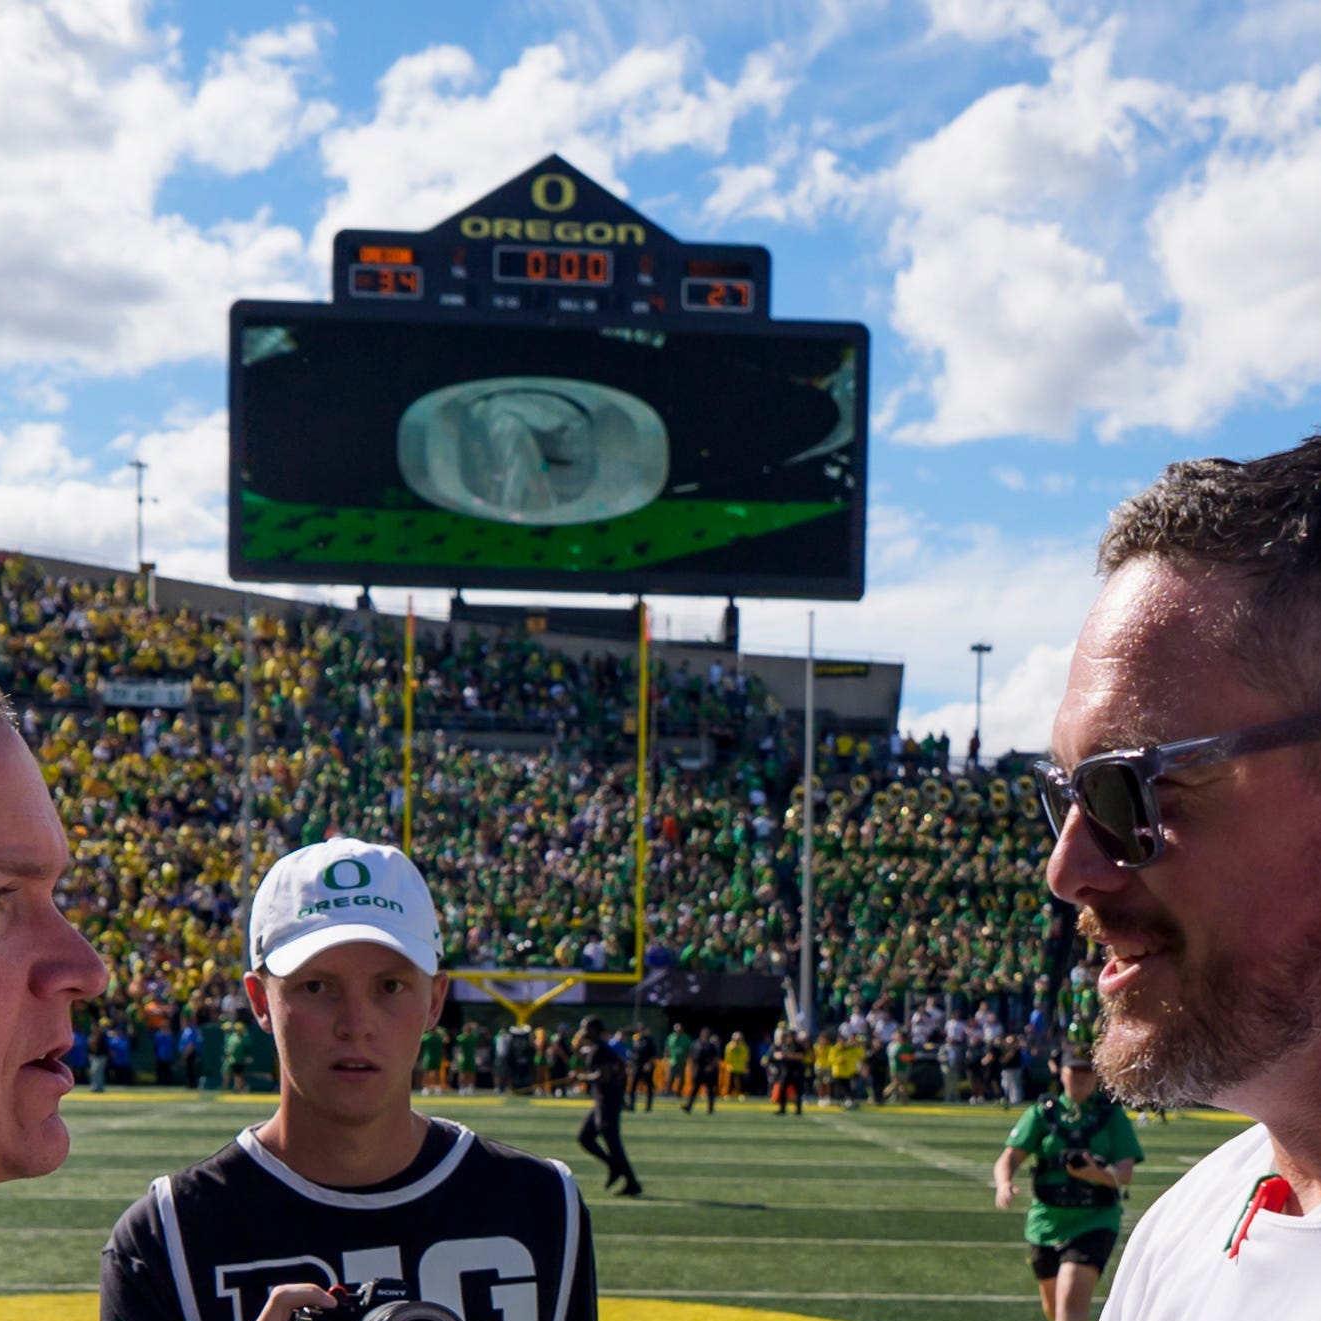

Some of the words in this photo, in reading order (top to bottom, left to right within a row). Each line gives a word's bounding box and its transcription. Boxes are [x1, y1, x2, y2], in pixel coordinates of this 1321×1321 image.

[460, 216, 646, 245] OREGON
[322, 859, 371, 890] O
[297, 895, 404, 919] OREGON
[377, 1289, 407, 1297] SONY
